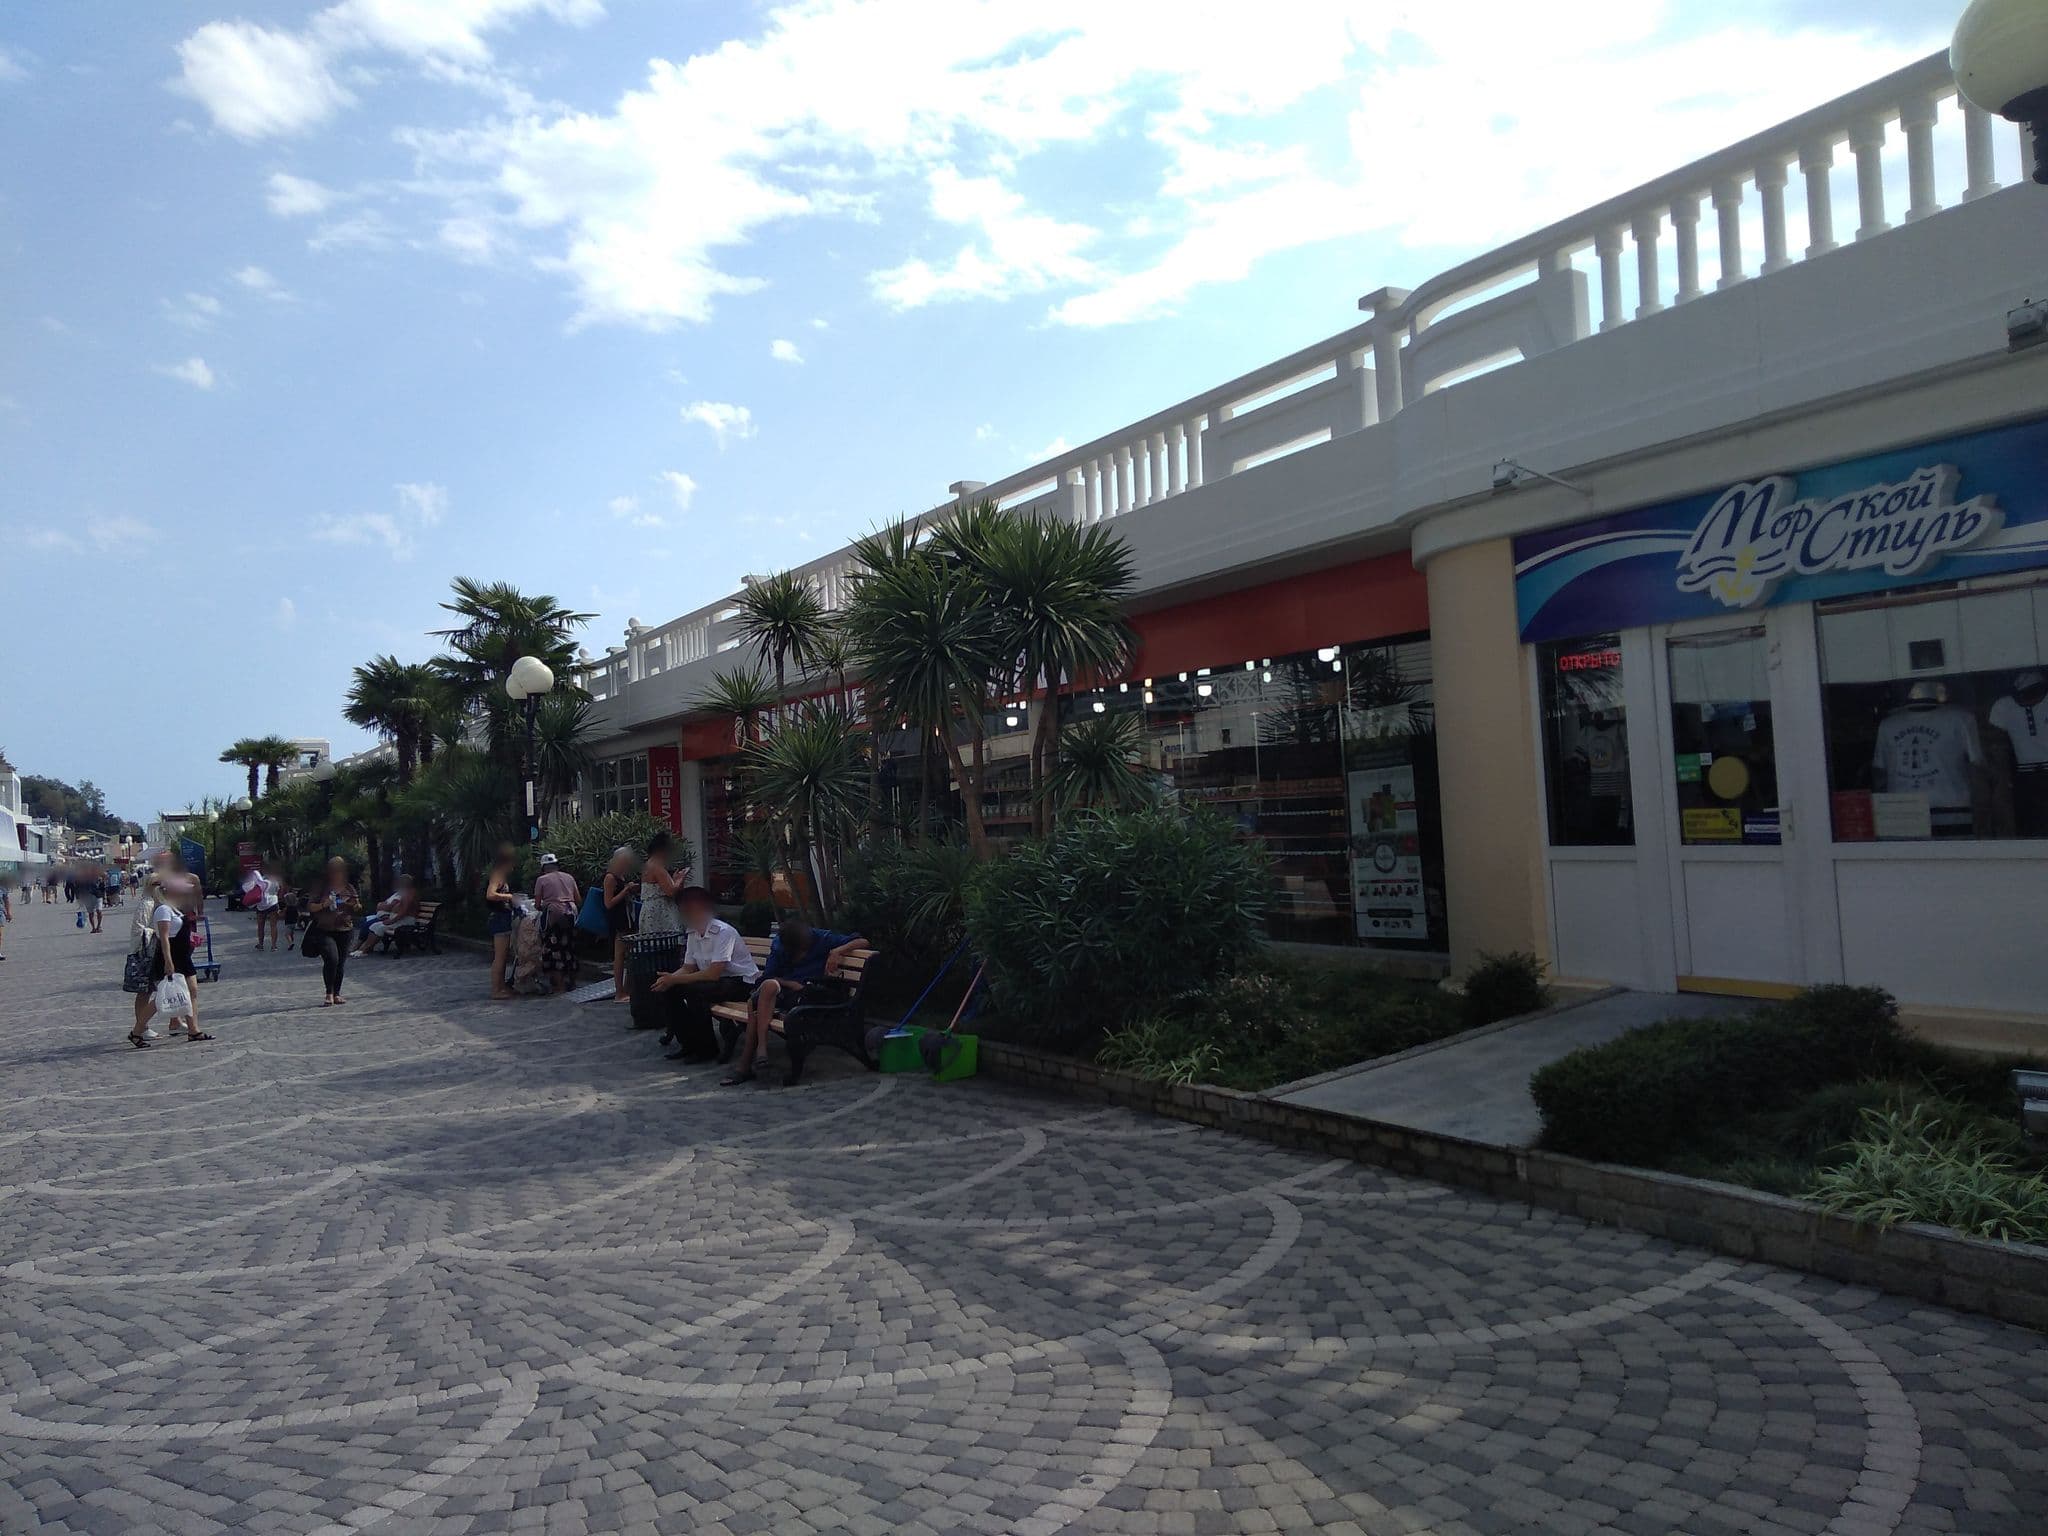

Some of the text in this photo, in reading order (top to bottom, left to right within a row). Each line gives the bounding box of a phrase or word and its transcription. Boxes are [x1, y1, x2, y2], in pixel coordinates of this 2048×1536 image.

[1690, 474, 1937, 553] Морской
[1798, 499, 1982, 569] Стиль
[1559, 652, 1620, 670] ОТКРЫТО
